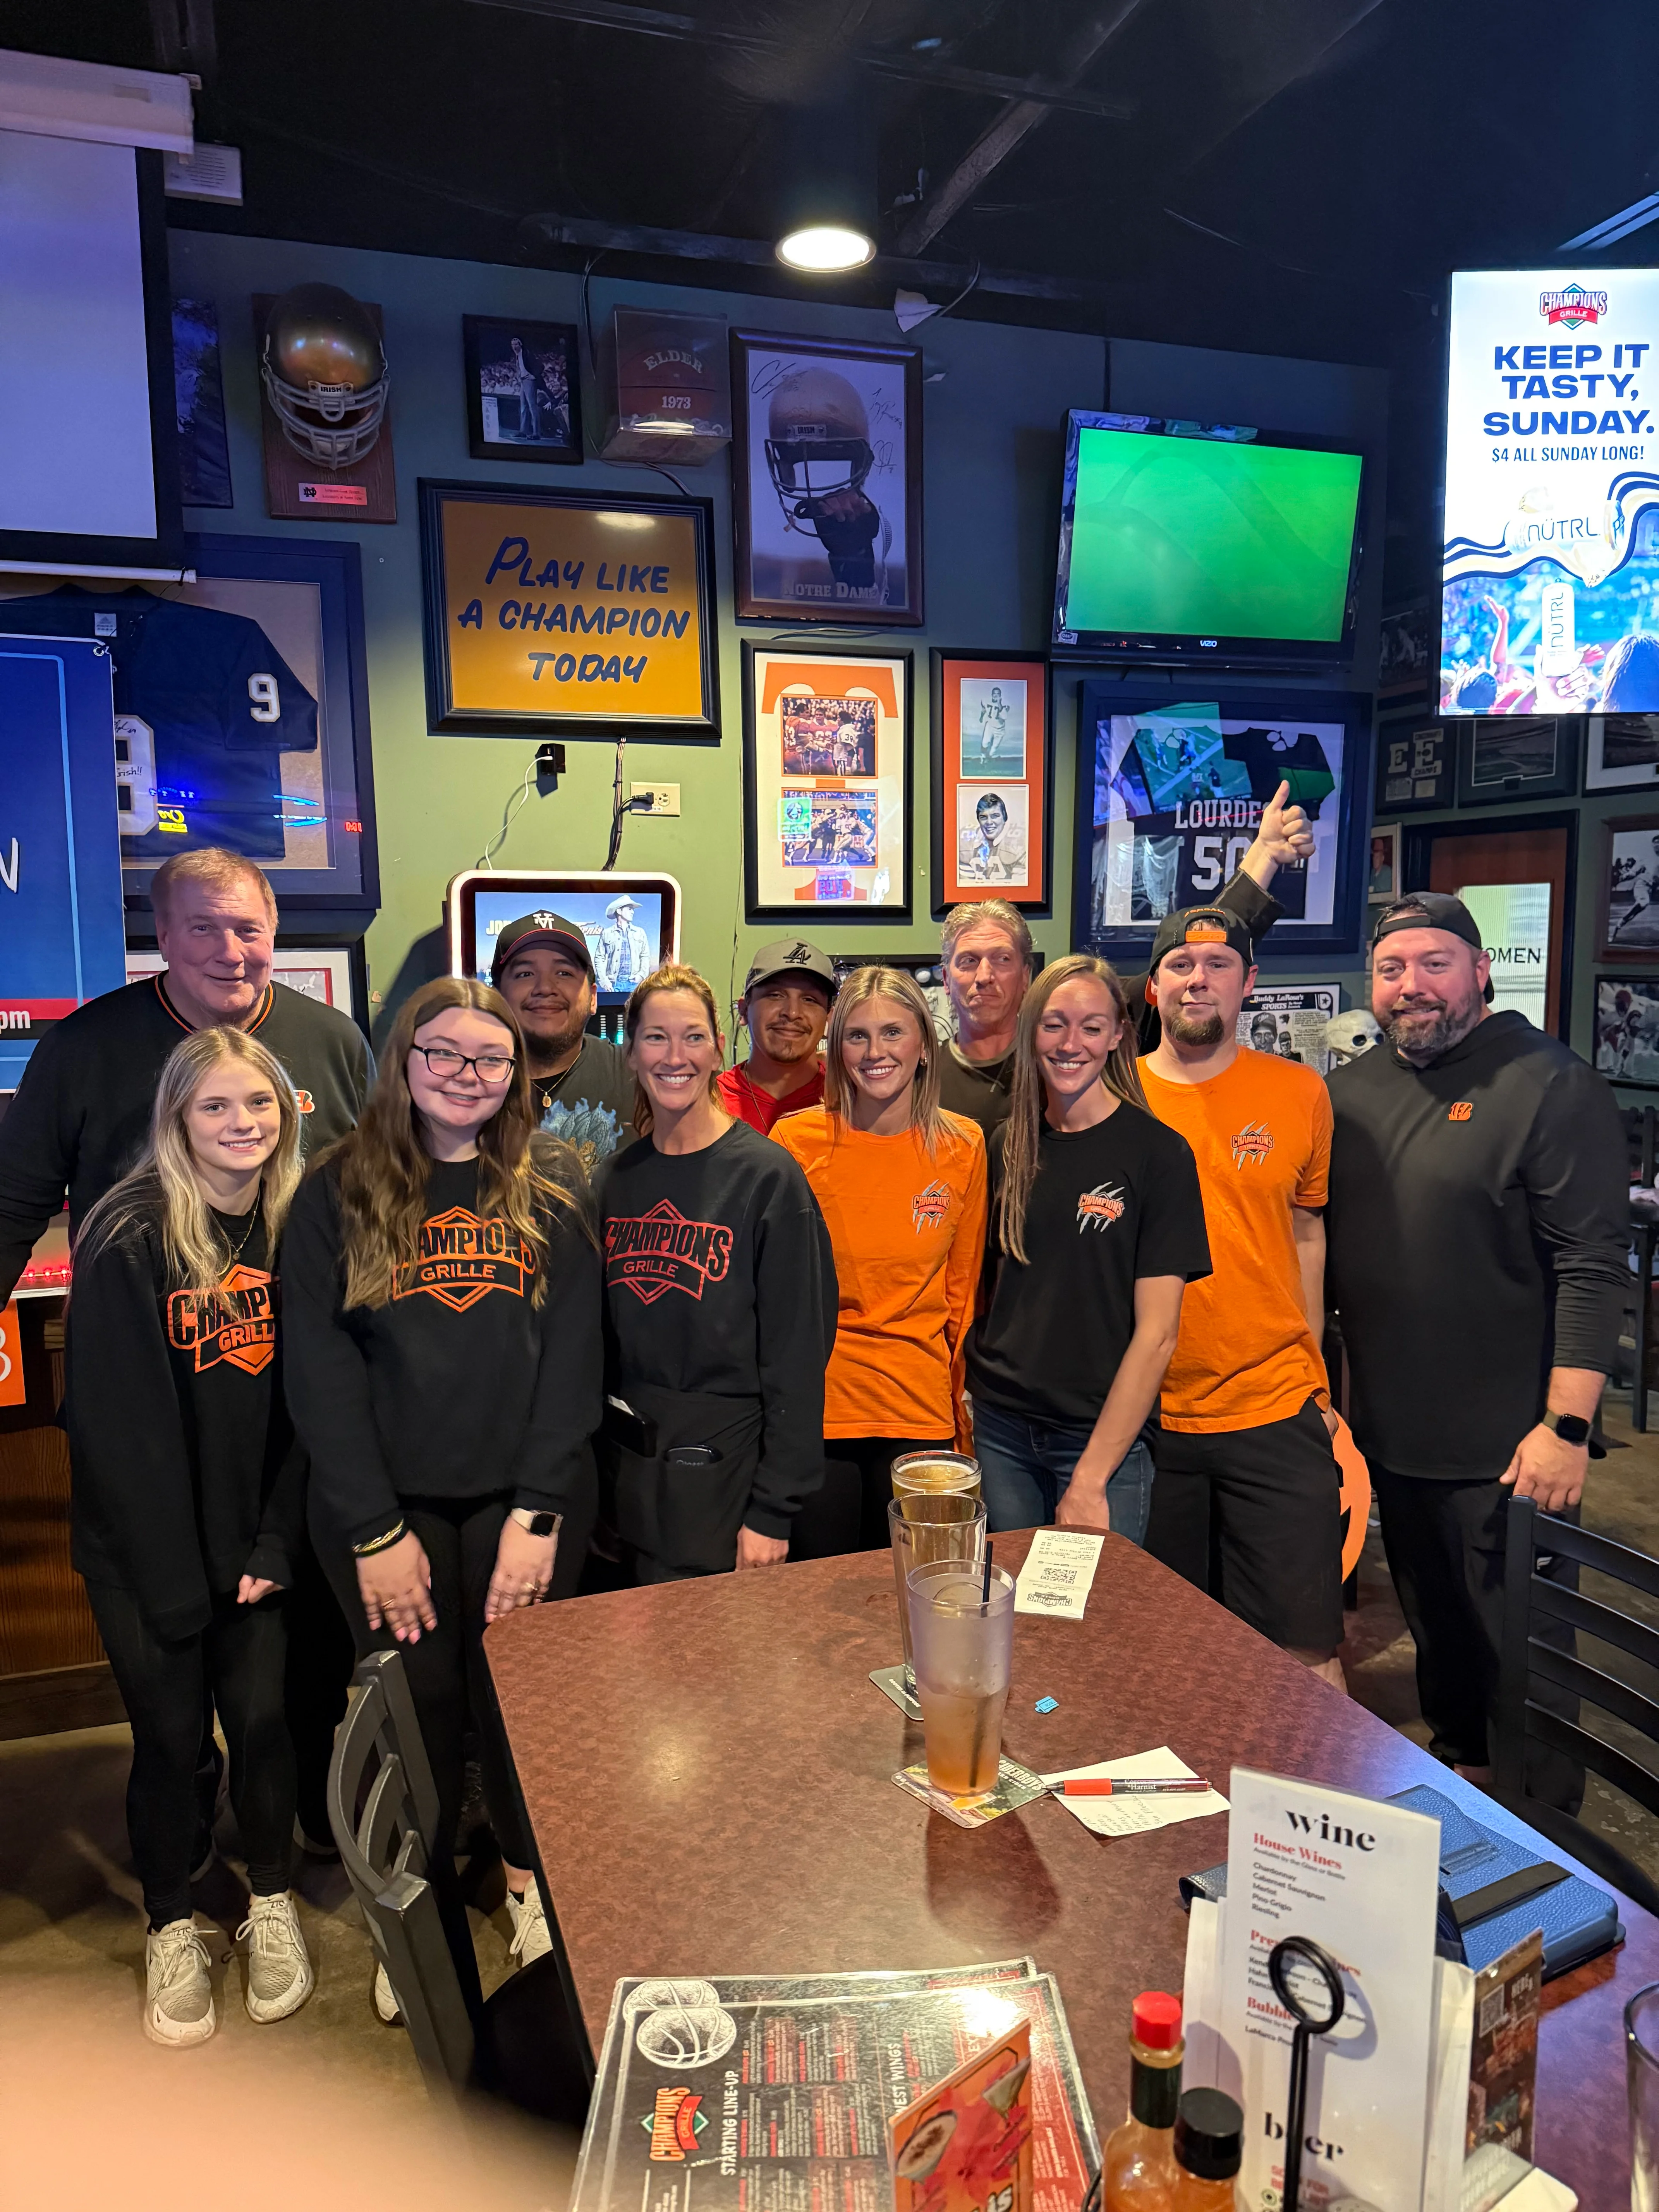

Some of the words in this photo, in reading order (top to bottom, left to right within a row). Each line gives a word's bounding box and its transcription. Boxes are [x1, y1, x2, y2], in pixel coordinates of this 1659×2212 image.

[1540, 292, 1607, 316] CHAMPIONS
[1559, 310, 1588, 318] GRILLE
[644, 350, 702, 374] ELDER
[1495, 345, 1602, 369] KEEP
[1614, 344, 1649, 368] IT
[1502, 374, 1639, 401] TASTY,
[662, 396, 691, 409] 1973
[1484, 410, 1654, 436] SUNDAY.
[1492, 447, 1509, 463] $4
[1514, 448, 1537, 462] ALL
[1542, 447, 1598, 461] SUNDAY
[1602, 446, 1644, 460] LONG!
[596, 562, 670, 594] LIKE
[836, 582, 876, 599] DAME
[458, 599, 483, 630] A
[499, 600, 691, 639] CHAMPION
[528, 652, 648, 684] TODAY
[248, 673, 281, 722] 9
[783, 943, 811, 965] LA
[1482, 948, 1540, 963] OMEN
[1232, 1135, 1273, 1148] CHAMPIONS
[1079, 1194, 1123, 1216] CHAMPIONS
[606, 1219, 732, 1280] CHAMPIONS
[421, 1264, 496, 1281] GRILLE
[623, 1261, 678, 1278] GRILLE
[219, 1323, 275, 1352] GRILL
[1285, 1810, 1376, 1851] wine
[1254, 1833, 1295, 1854] House
[1299, 1846, 1342, 1870] Wines
[1253, 1862, 1297, 1882] Chardonnay
[1252, 1882, 1277, 1896] Merlot
[1253, 1872, 1286, 1888] Cabernet
[1287, 1883, 1326, 1901] Sauvignon
[1252, 1903, 1280, 1919] Riesling
[1270, 1899, 1292, 1911] Grigio
[888, 2043, 905, 2081] WINGS
[723, 2070, 739, 2116] LINE-UP
[649, 2087, 691, 2161] CHAMPIONS
[682, 2106, 692, 2138] GRILLE
[720, 2117, 738, 2176] STARTING
[1265, 2112, 1343, 2161] ber
